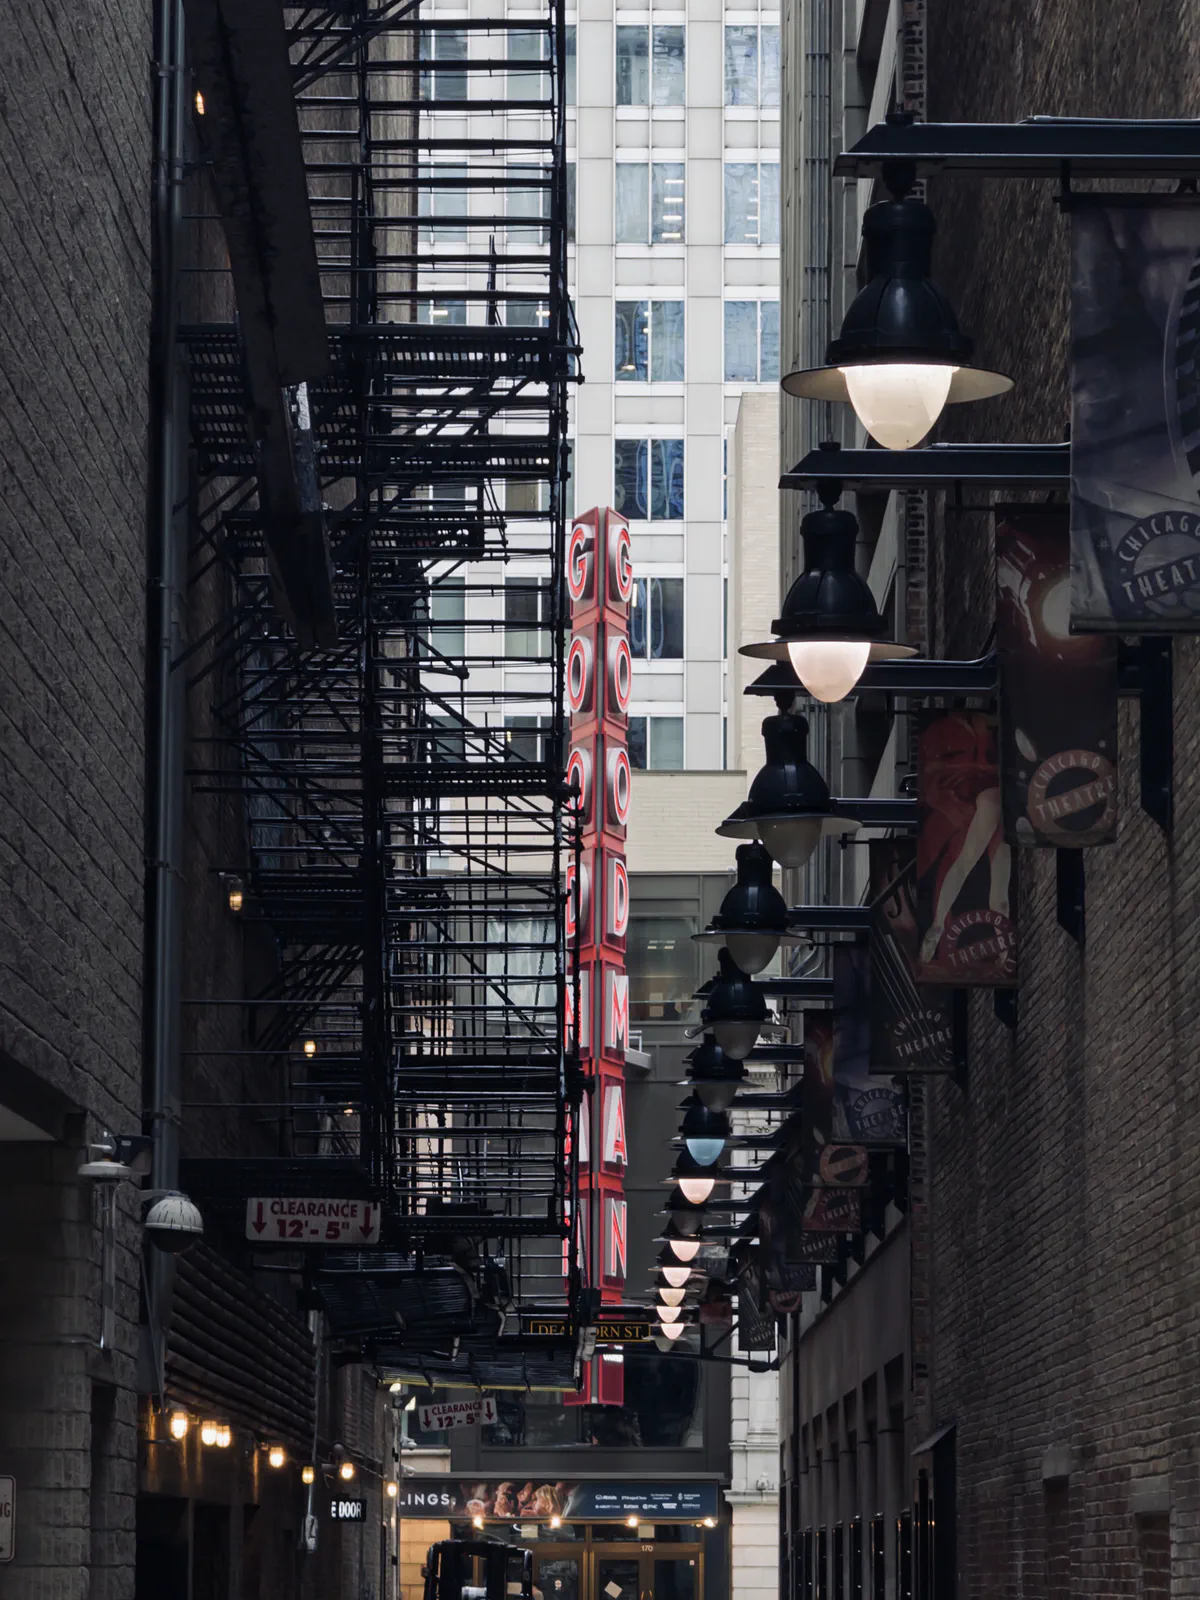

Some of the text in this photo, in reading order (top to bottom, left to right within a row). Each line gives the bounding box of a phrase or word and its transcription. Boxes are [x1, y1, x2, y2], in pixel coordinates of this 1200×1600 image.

[1034, 753, 1101, 789] CHICAGO
[1036, 776, 1116, 820] THEATRE
[606, 524, 633, 1281] GOODMAN
[947, 911, 1002, 941] CHICAGO
[948, 931, 1016, 967] THEATRE
[894, 1010, 941, 1036] CHICAGO
[896, 1025, 953, 1057] THEATRE
[270, 1201, 358, 1218] CLEARANCE
[431, 1401, 483, 1416] CLEARANCE
[338, 1501, 362, 1518] DOOR
